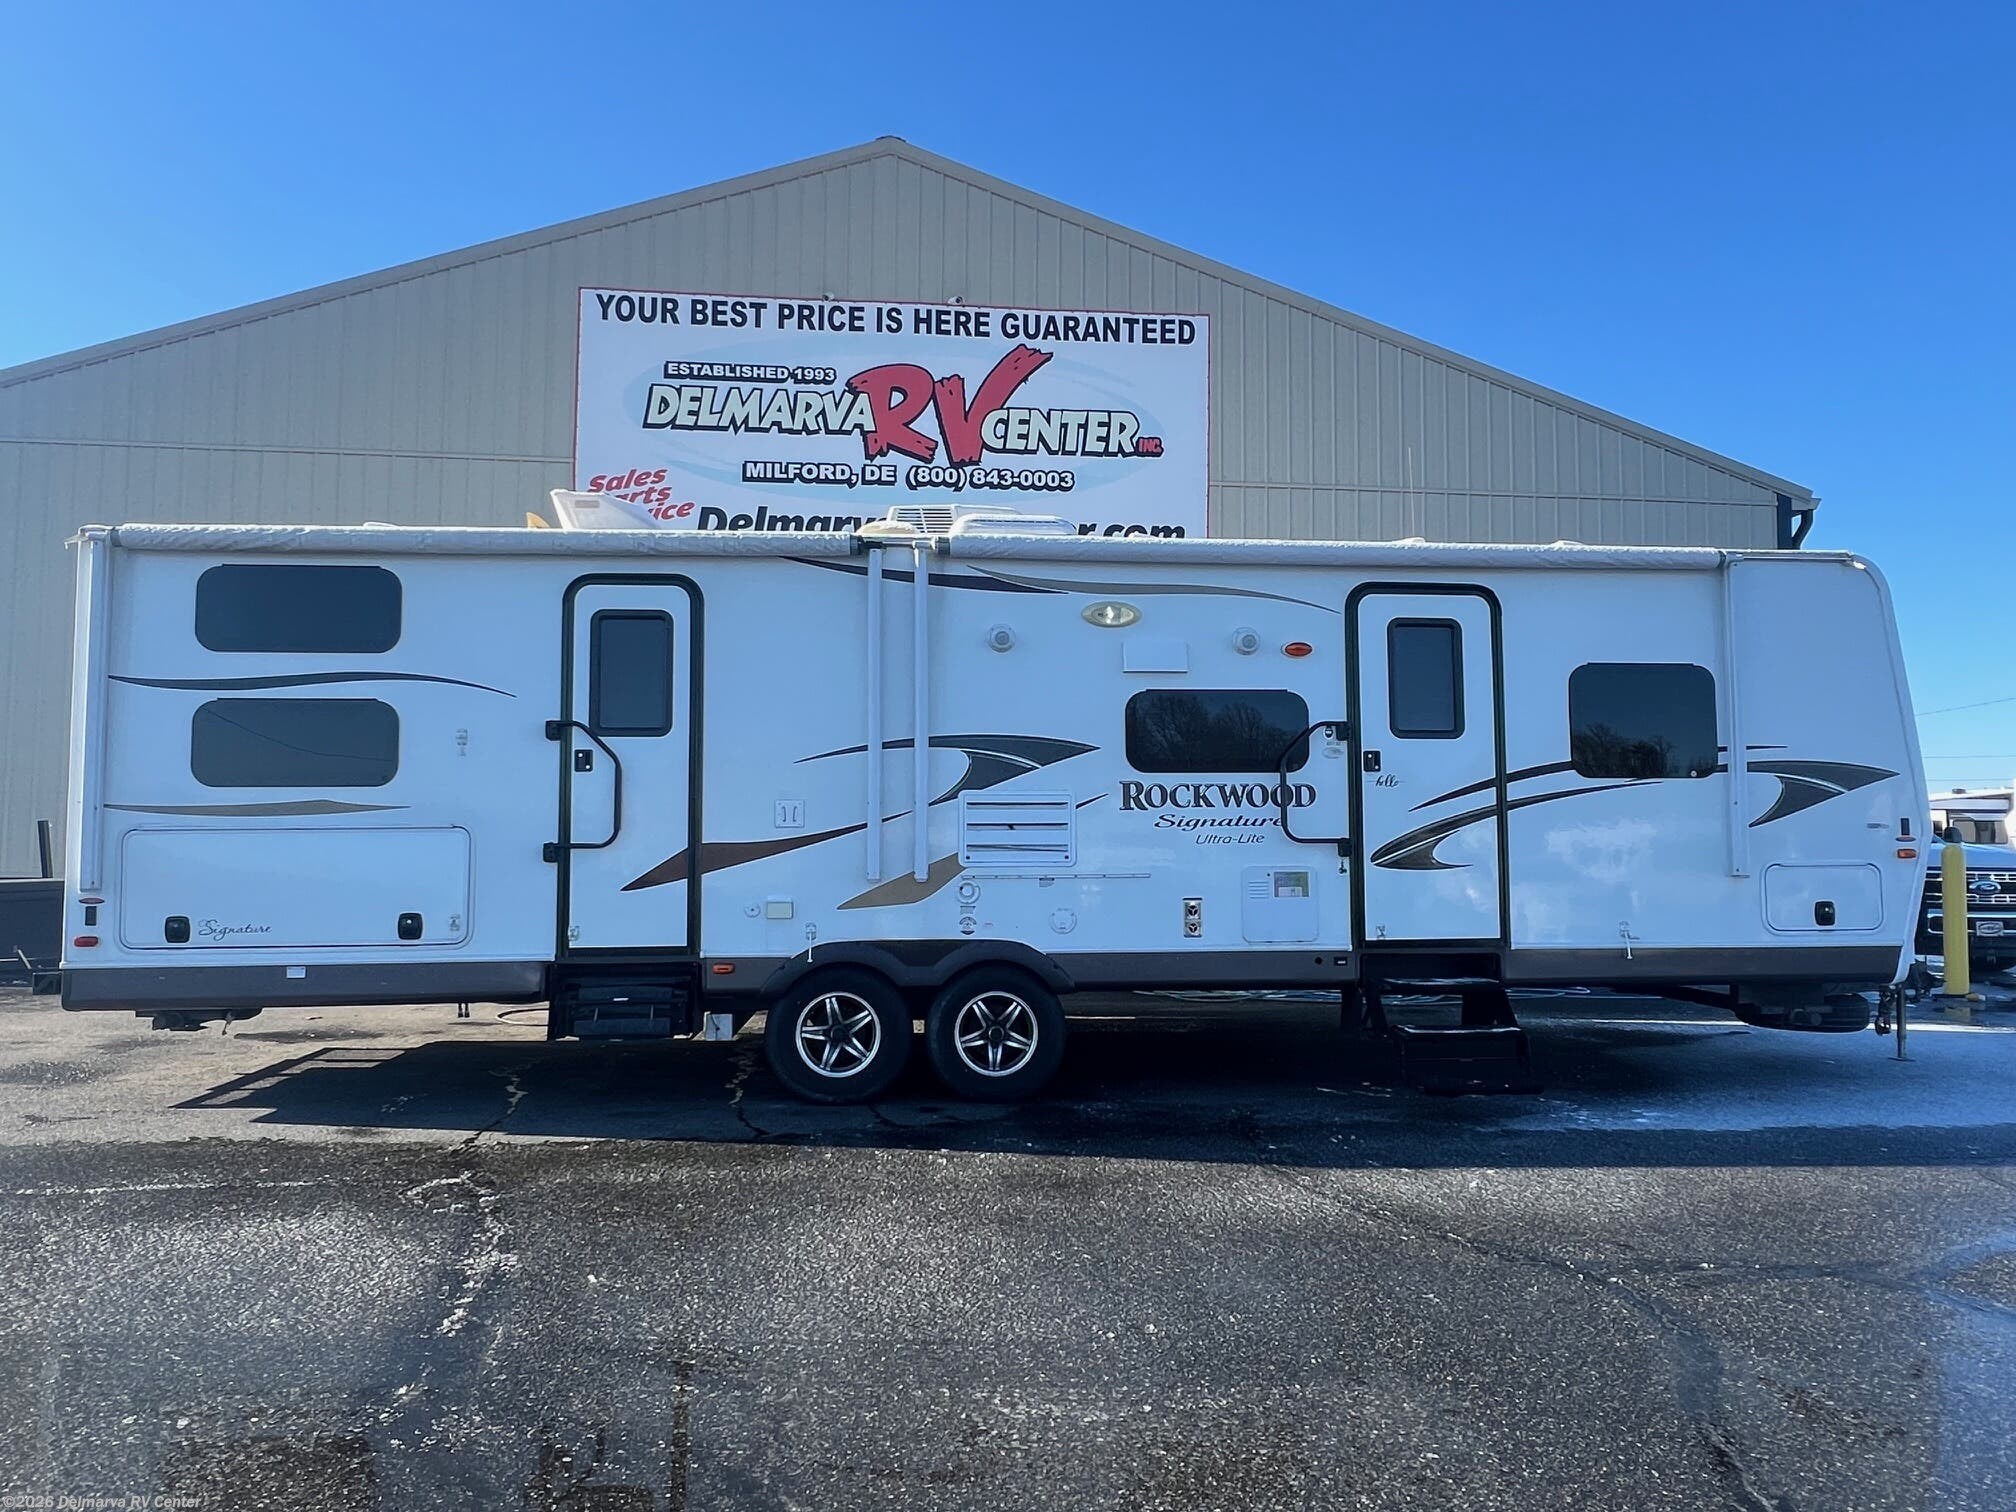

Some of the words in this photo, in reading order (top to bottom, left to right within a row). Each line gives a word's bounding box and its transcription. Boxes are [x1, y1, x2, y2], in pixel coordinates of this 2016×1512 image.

[596, 293, 680, 325] YOUR
[690, 298, 767, 328] BEST
[778, 303, 865, 332] PRICE
[876, 307, 902, 334] IS
[913, 308, 990, 338] HERE
[1000, 312, 1196, 345] GUARANTEED
[665, 361, 789, 382] ESTABLISHED
[791, 365, 839, 385] 1993
[643, 384, 877, 436] DELMARVA
[845, 343, 1055, 466] RV
[980, 408, 1140, 457] CENTER
[587, 468, 669, 493] Sales
[743, 461, 859, 488] MILFORD,
[862, 464, 897, 486] DE
[906, 465, 967, 492] (800)
[971, 468, 1075, 491] 843-0003
[604, 486, 673, 504] rts
[1119, 780, 1316, 811] ROCKWOOD
[1154, 813, 1283, 832] Signature
[1195, 833, 1265, 845] Ultra-Lite
[198, 919, 272, 941] Signature
